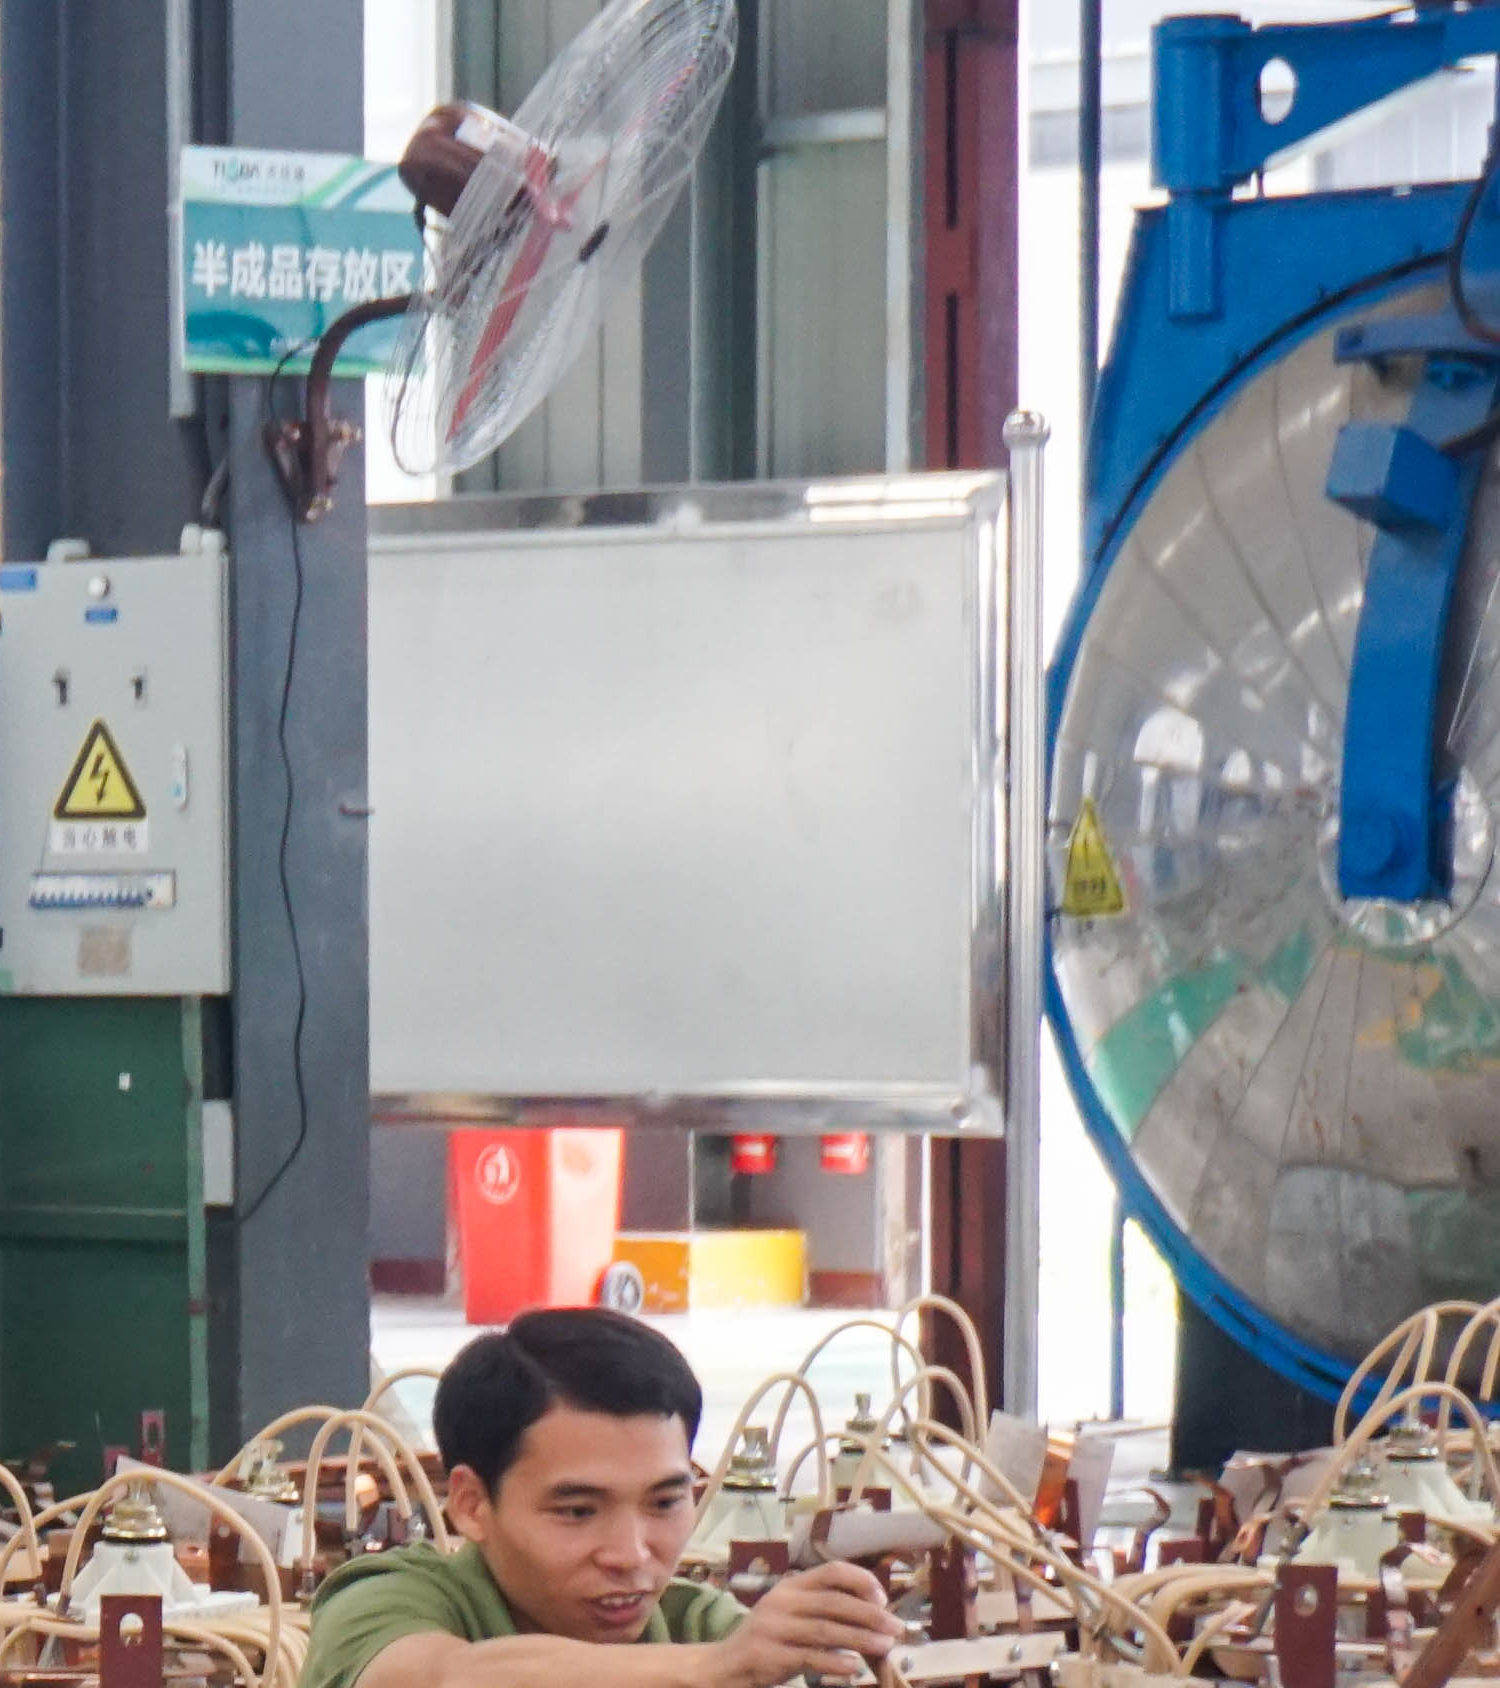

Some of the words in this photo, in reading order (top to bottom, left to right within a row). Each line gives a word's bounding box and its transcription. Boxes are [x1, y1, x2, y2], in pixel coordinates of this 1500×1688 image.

[192, 239, 415, 300] 半成品存放区
